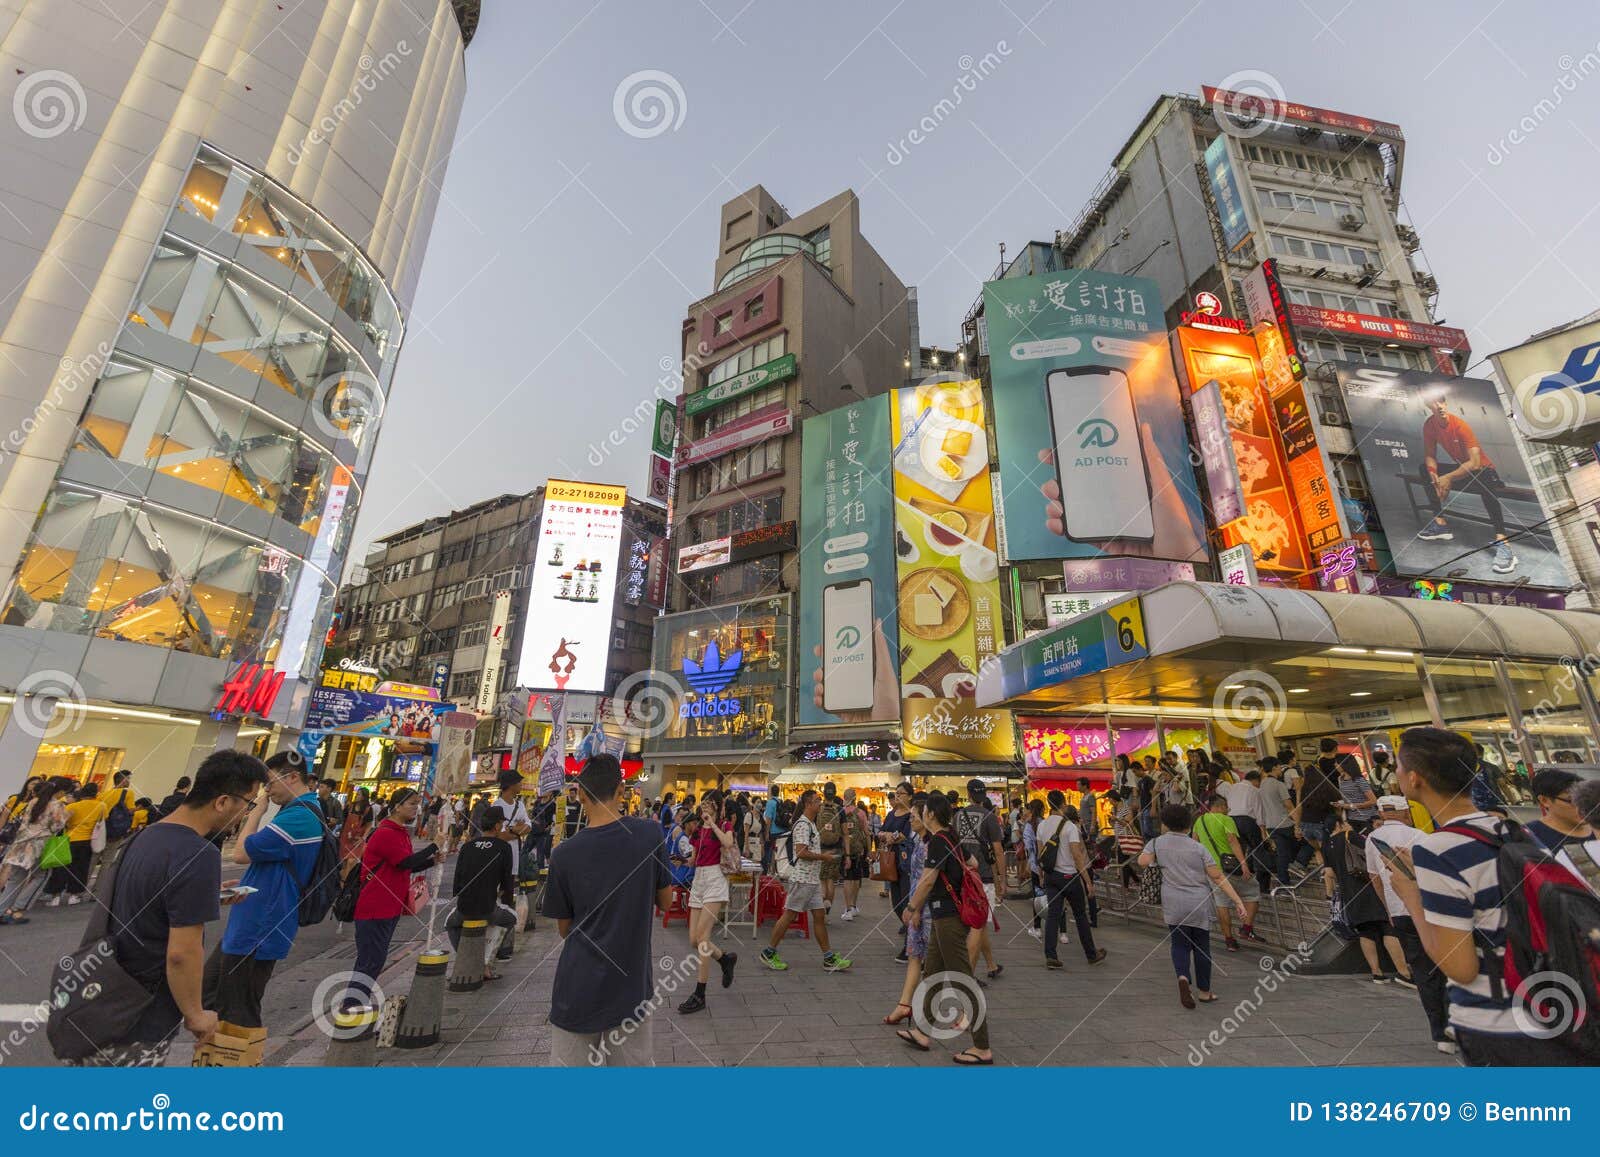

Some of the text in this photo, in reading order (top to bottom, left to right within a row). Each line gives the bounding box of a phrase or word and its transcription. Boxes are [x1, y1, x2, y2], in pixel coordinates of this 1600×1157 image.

[1212, 315, 1248, 334] STONE
[1360, 320, 1393, 333] HOTEL
[1075, 456, 1128, 467] AD POST
[1051, 599, 1090, 615] 玉芙蓉
[1116, 616, 1135, 653] 6
[832, 655, 843, 664] AD
[1042, 636, 1079, 665] 西門站
[1043, 659, 1082, 677] XIMEN STATION
[216, 660, 286, 719] H&M
[481, 667, 495, 705] hair salon
[679, 697, 741, 720] adidas
[1074, 734, 1101, 744] EYA
[1075, 738, 1113, 766] FLOWE
